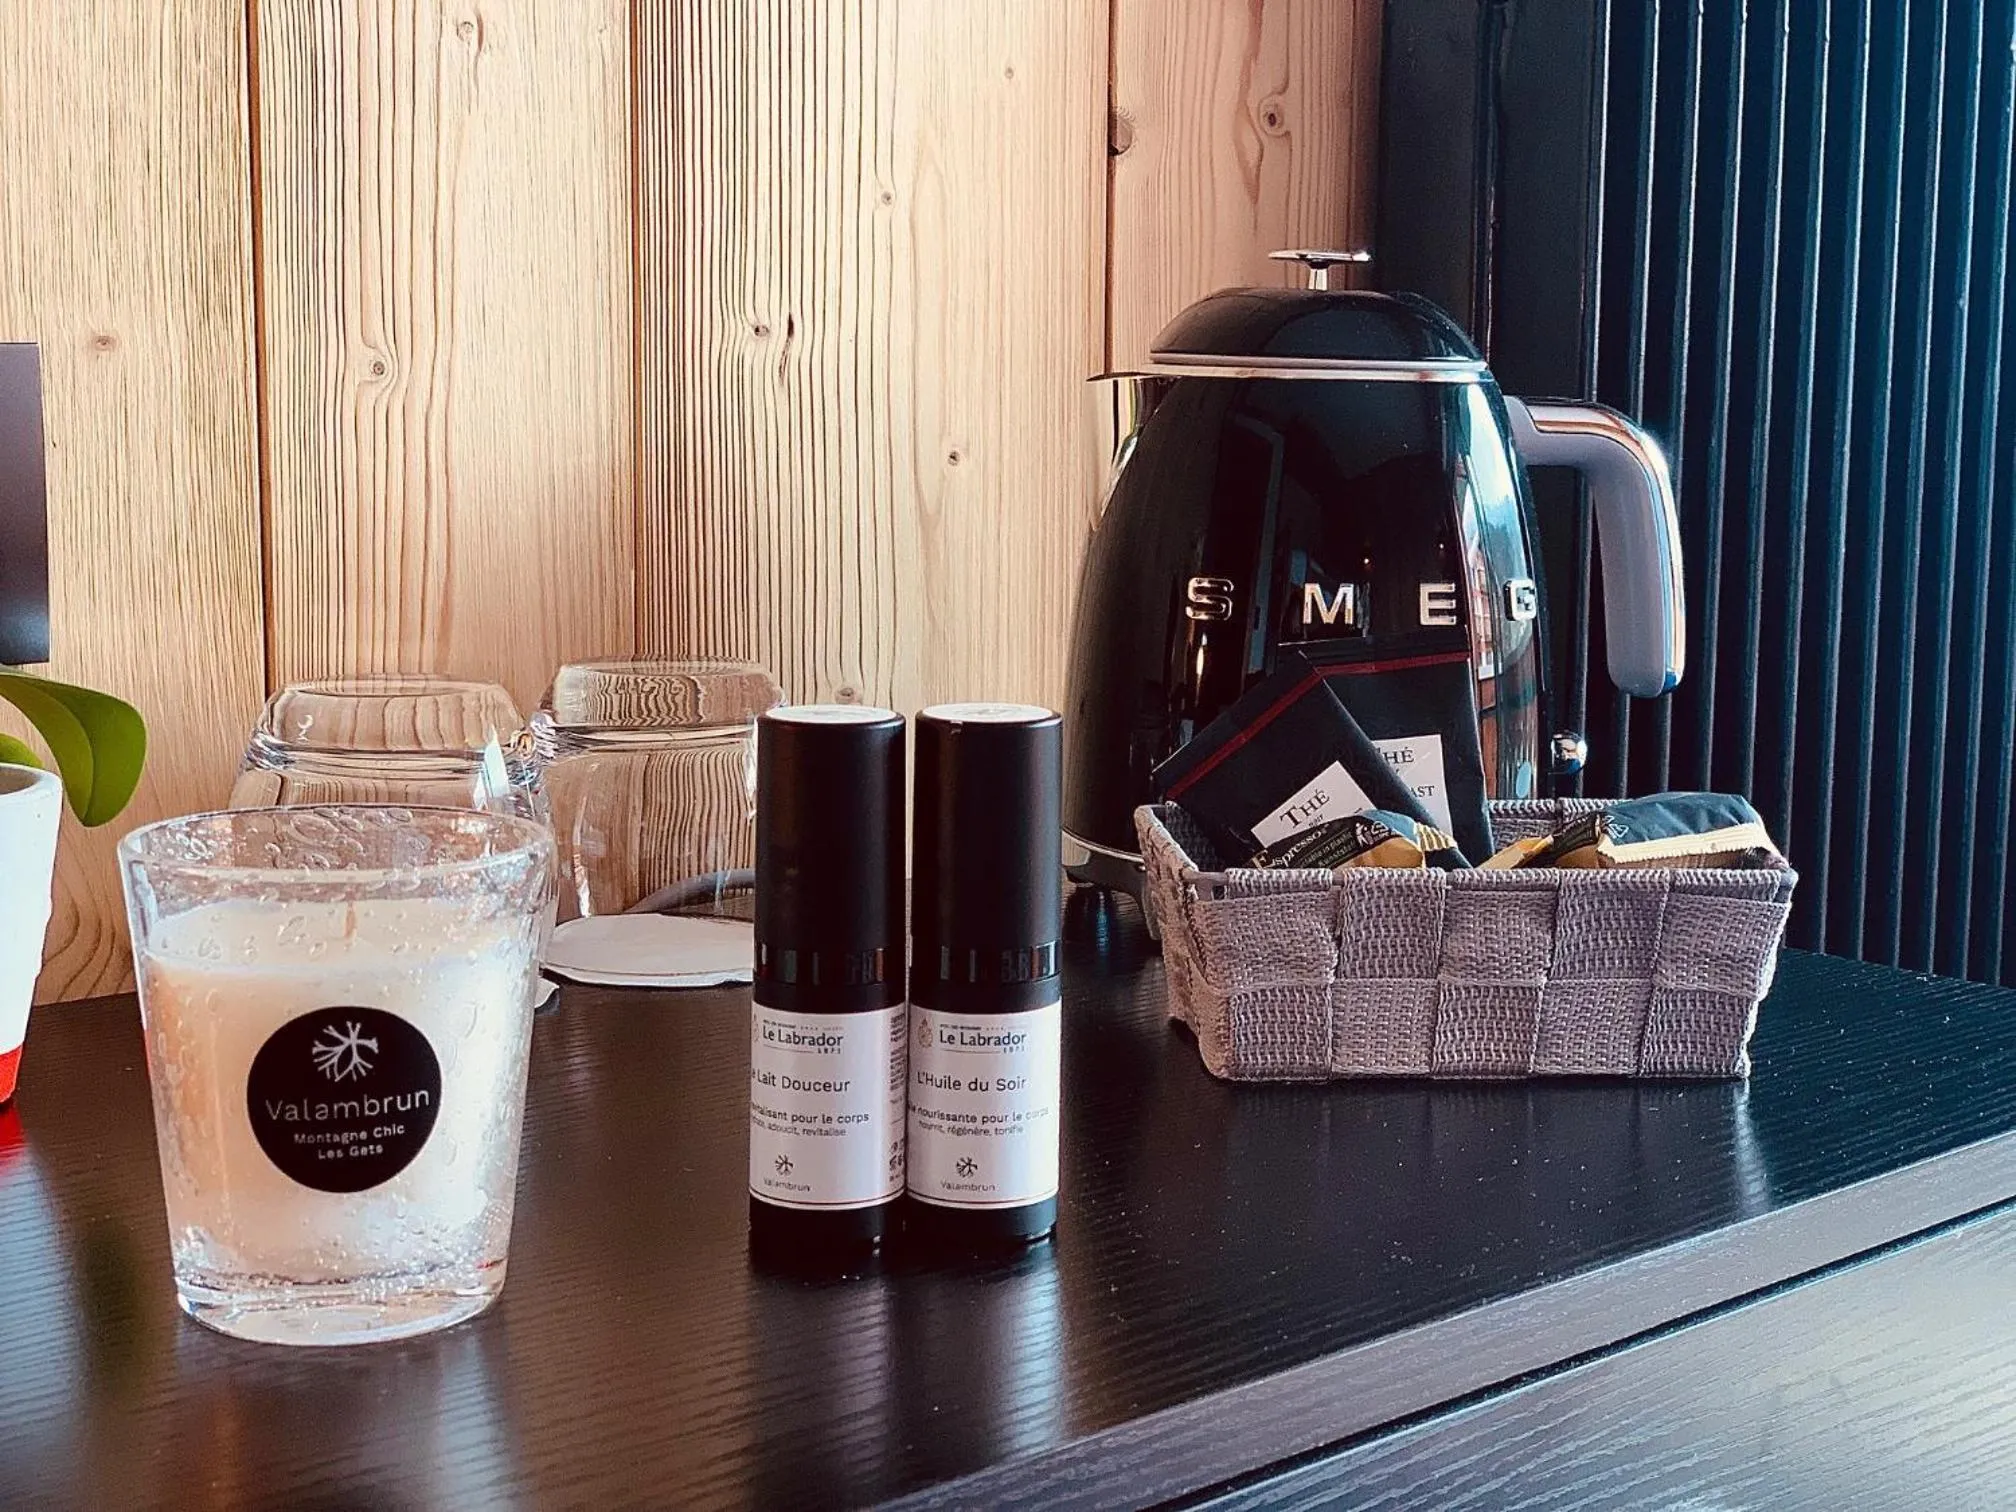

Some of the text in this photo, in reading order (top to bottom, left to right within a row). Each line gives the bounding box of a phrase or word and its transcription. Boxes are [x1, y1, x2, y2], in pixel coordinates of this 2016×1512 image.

[1185, 576, 1537, 627] SMEG
[1279, 788, 1331, 829] THÉ
[762, 1025, 844, 1047] Le Labrador
[939, 1029, 1027, 1047] Le Labrador
[757, 1068, 777, 1087] Lait
[781, 1075, 851, 1092] Douceur
[917, 1070, 1026, 1092] L'Huile du Soir
[265, 1089, 430, 1121] Valambrun
[791, 1113, 818, 1125] pour
[822, 1113, 833, 1125] le
[837, 1113, 870, 1125] corps
[981, 1115, 1009, 1126] pour
[1012, 1110, 1023, 1122] le
[293, 1123, 406, 1144] Montagne Chic
[317, 1149, 344, 1160] Les
[940, 1179, 996, 1192] Valambrun
